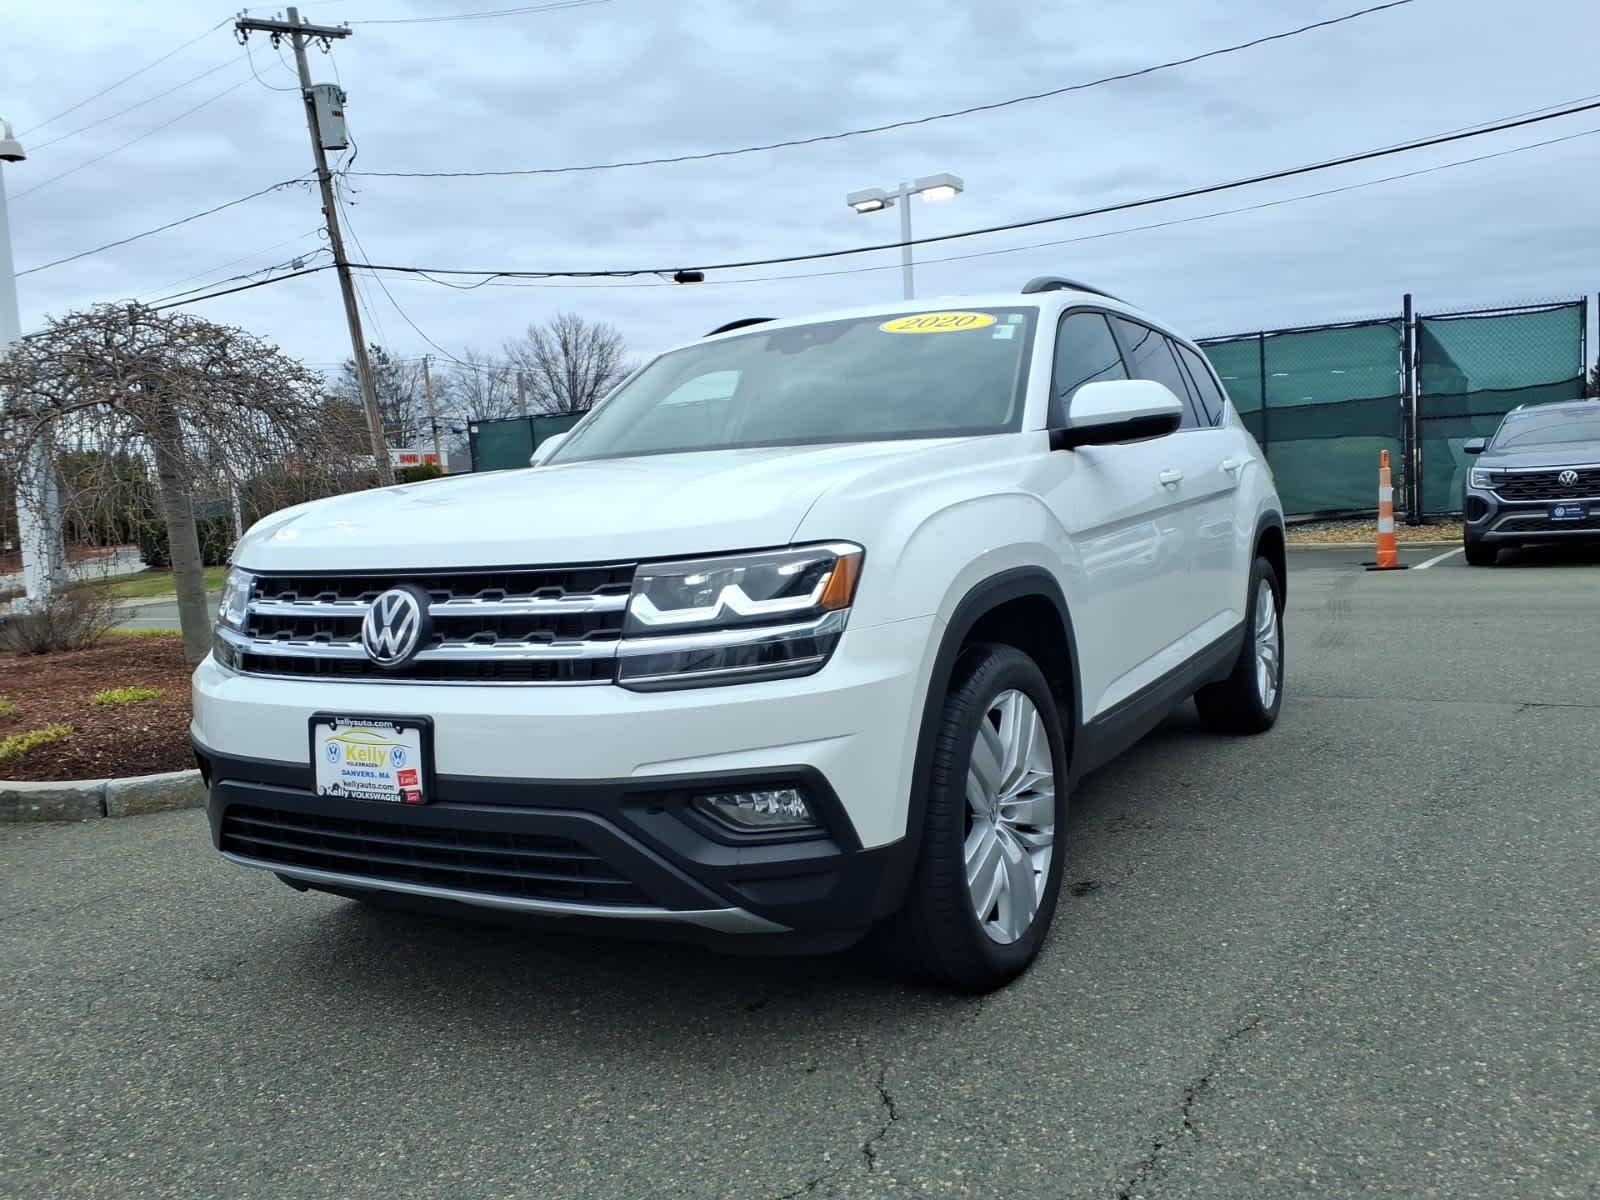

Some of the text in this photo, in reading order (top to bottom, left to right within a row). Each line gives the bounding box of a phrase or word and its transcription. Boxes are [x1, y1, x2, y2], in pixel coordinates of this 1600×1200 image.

[897, 315, 977, 330] 2020
[362, 589, 420, 666] VW
[336, 718, 393, 729] kellyauto.com
[346, 745, 387, 768] Kelly
[343, 780, 394, 790] kellyauto.com
[326, 787, 349, 798] Kelly
[351, 791, 401, 802] VOLKSWAGEN
